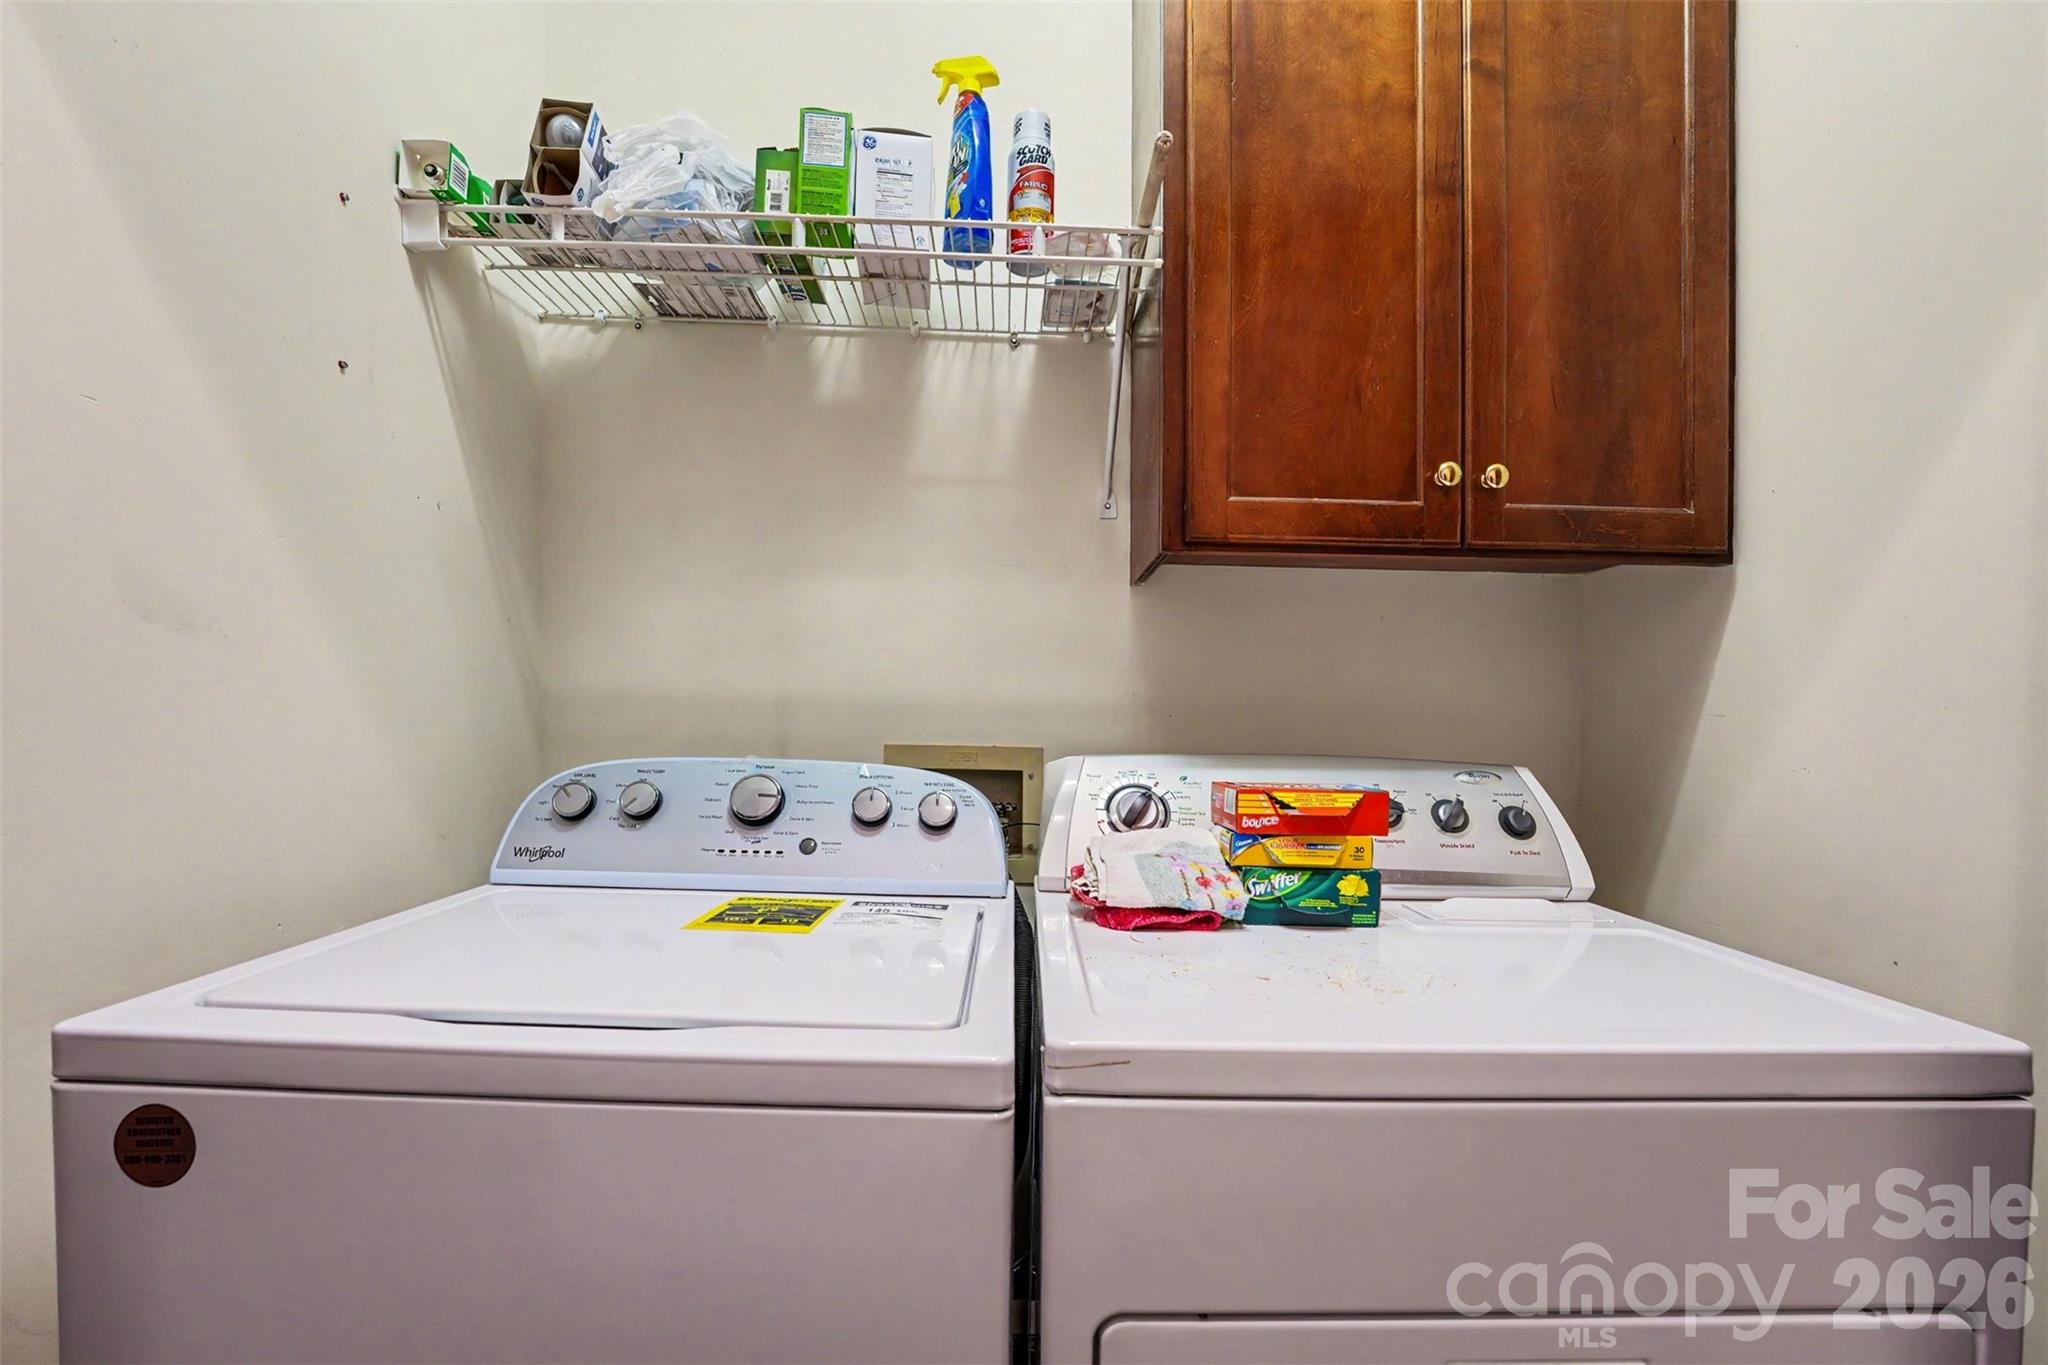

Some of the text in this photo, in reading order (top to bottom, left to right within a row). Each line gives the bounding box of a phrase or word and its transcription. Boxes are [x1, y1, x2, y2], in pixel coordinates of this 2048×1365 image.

[1016, 144, 1052, 159] SCOTCH
[1019, 154, 1048, 167] GARD
[1241, 815, 1280, 830] bounce
[514, 845, 566, 863] Whirlpool
[1247, 872, 1301, 898] Swiffer
